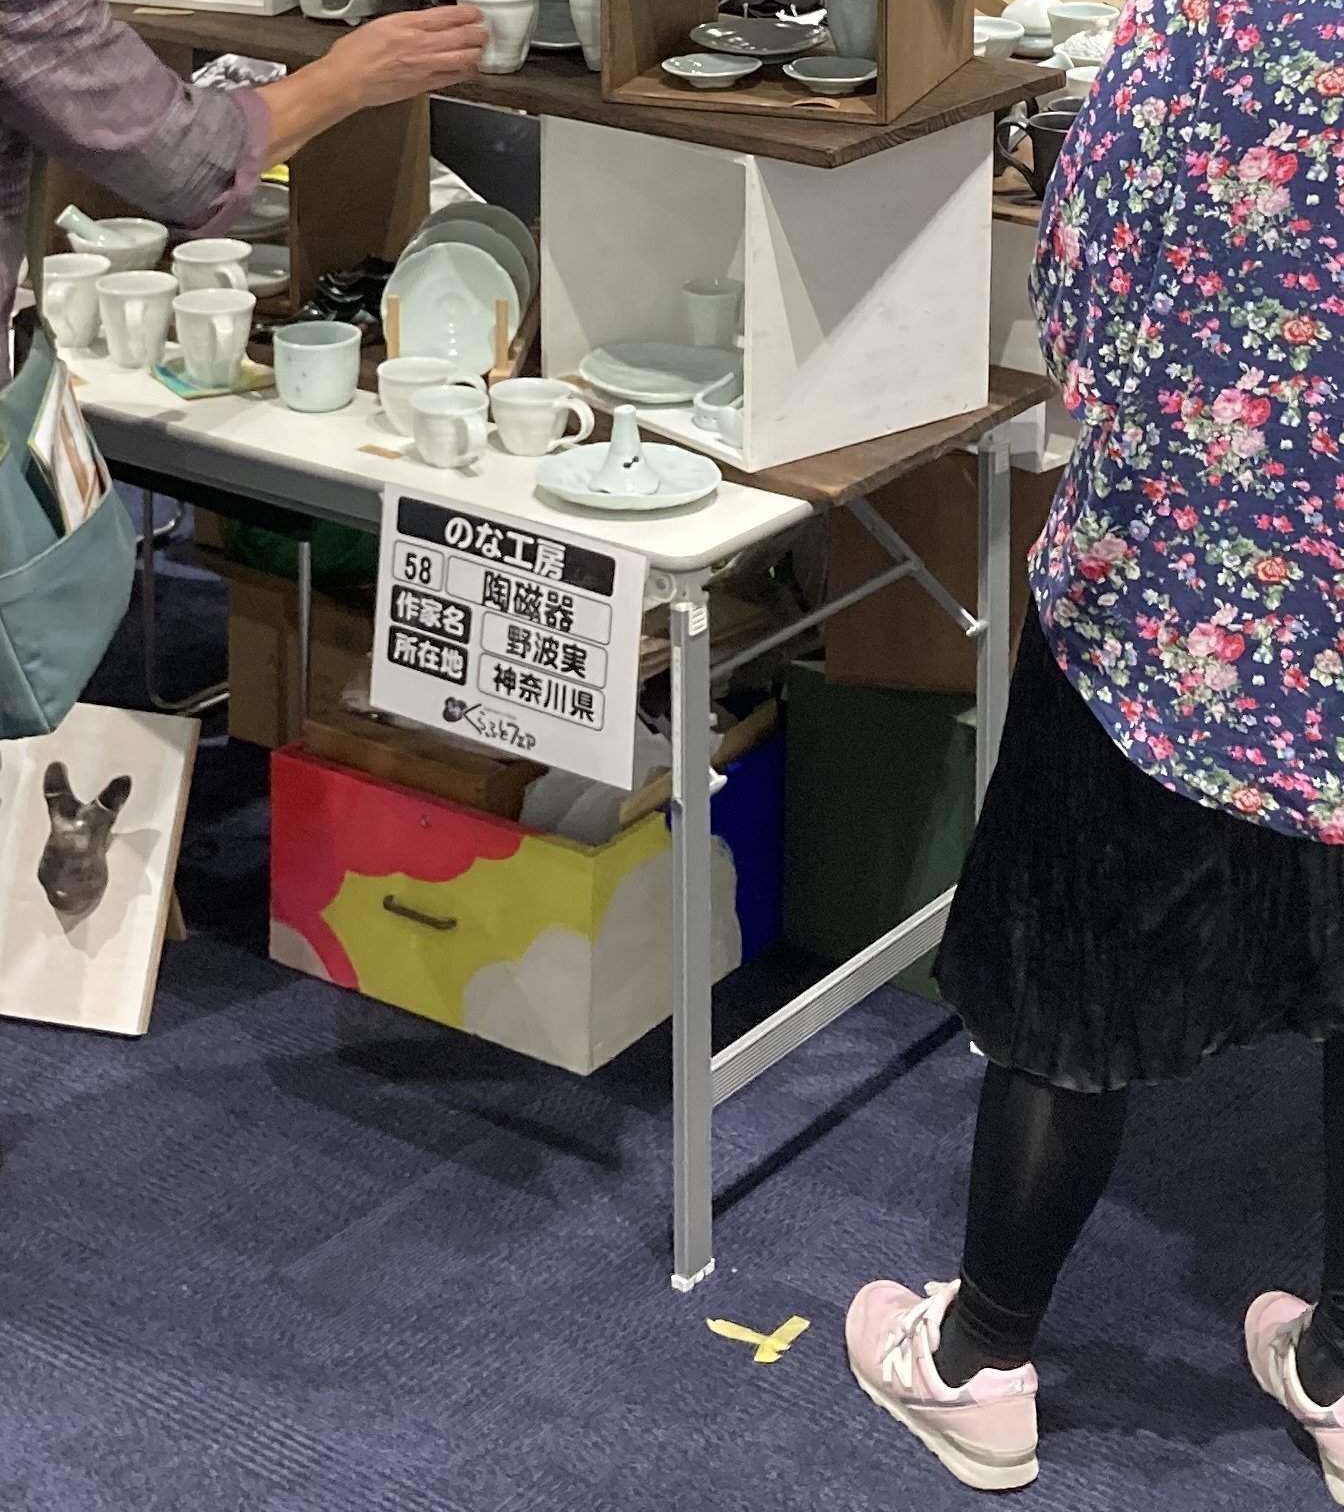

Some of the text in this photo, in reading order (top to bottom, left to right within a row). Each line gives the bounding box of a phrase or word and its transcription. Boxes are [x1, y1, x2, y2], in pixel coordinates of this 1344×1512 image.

[404, 552, 432, 585] 58
[443, 515, 567, 582] のな工房
[395, 591, 465, 637] 作家名
[482, 570, 575, 635] 陶磁器
[393, 633, 464, 679] 所在地
[505, 624, 588, 680] 野波実
[492, 662, 595, 723] 神奈川県
